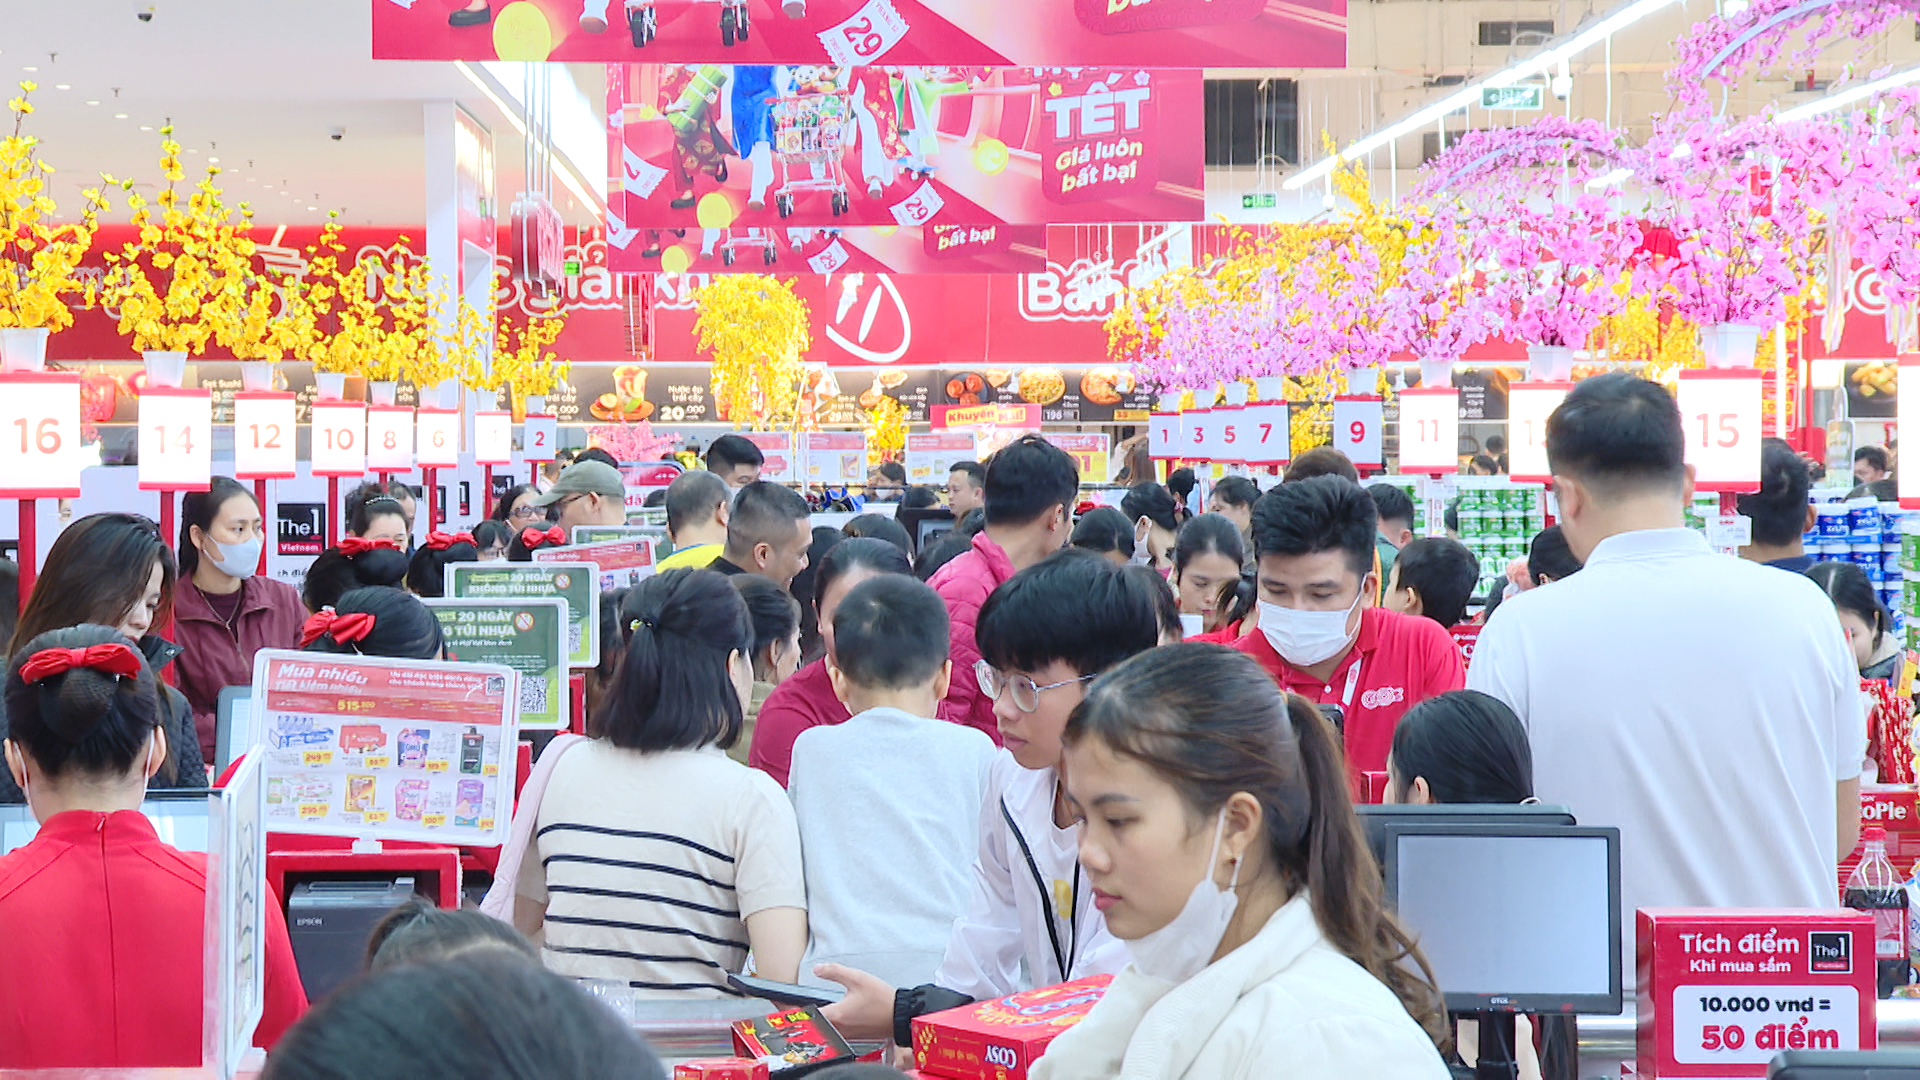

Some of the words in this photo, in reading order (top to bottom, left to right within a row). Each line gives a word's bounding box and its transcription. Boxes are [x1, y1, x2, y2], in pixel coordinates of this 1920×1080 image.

[842, 16, 883, 56] 29
[1045, 72, 1150, 138] TẾT
[1055, 143, 1091, 171] Giá
[1094, 137, 1143, 160] luôn
[1062, 163, 1099, 193] bất
[13, 417, 62, 454] 16
[154, 425, 195, 454] 14
[249, 424, 282, 449] 12
[323, 428, 355, 450] 10
[383, 430, 397, 450] 8
[433, 430, 444, 448] 6
[535, 431, 545, 446] 2
[1162, 429, 1168, 443] 1
[1193, 427, 1204, 443] 3
[1224, 425, 1236, 443] 5
[1259, 424, 1272, 443] 7
[1349, 421, 1366, 443] 9
[1417, 419, 1439, 442] 11
[1696, 413, 1740, 448] 15
[458, 611, 475, 622] 20
[478, 608, 514, 622] NGÀY
[278, 663, 315, 678] Mua
[1679, 932, 1731, 954] Tích
[1738, 927, 1800, 954] điểm
[1690, 959, 1716, 972] Khi
[1720, 961, 1754, 972] mua
[1758, 956, 1791, 972] sắm
[1699, 997, 1770, 1012] 10.000
[1775, 997, 1814, 1012] vnd
[1701, 1024, 1745, 1051] 50
[1755, 1016, 1839, 1050] điểm
[985, 1044, 1017, 1070] COSY
